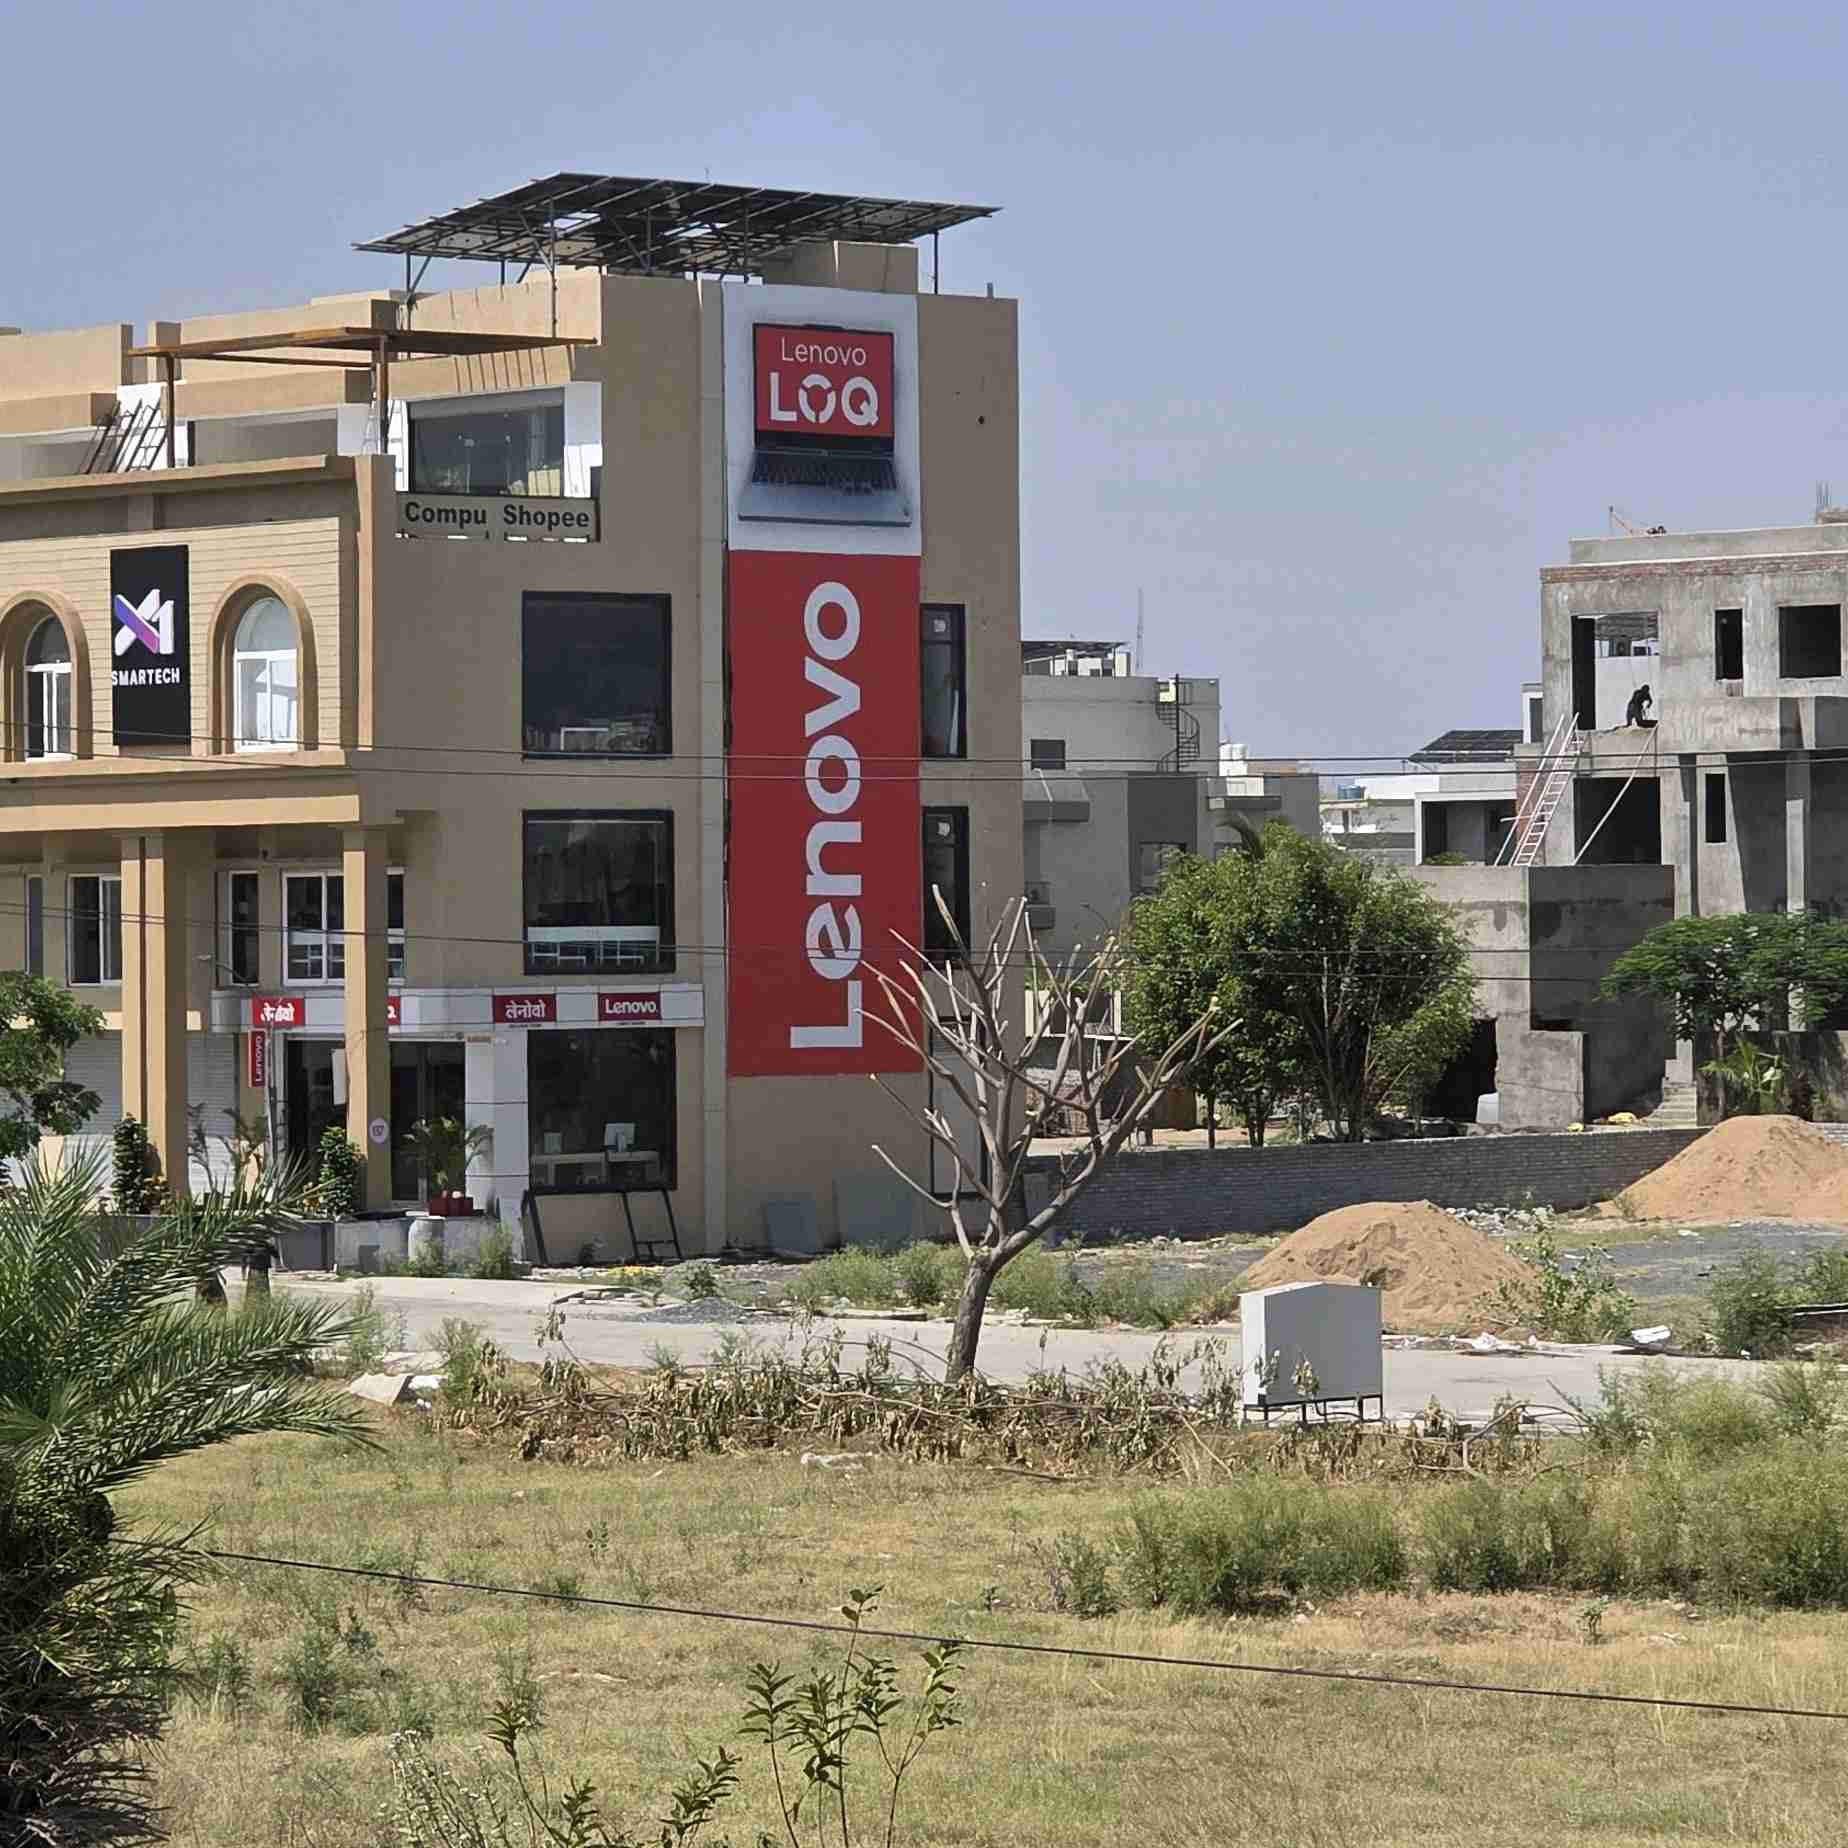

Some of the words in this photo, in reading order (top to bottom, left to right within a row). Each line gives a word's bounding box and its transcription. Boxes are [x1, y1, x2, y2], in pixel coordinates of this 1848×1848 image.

[781, 337, 867, 366] Lenovo
[769, 372, 879, 426] LOQ
[405, 501, 487, 528] Compu
[503, 504, 590, 531] Shopee
[112, 667, 180, 686] SMARTECH
[790, 581, 862, 1048] Lenovo
[505, 1000, 546, 1019] लेनोवो
